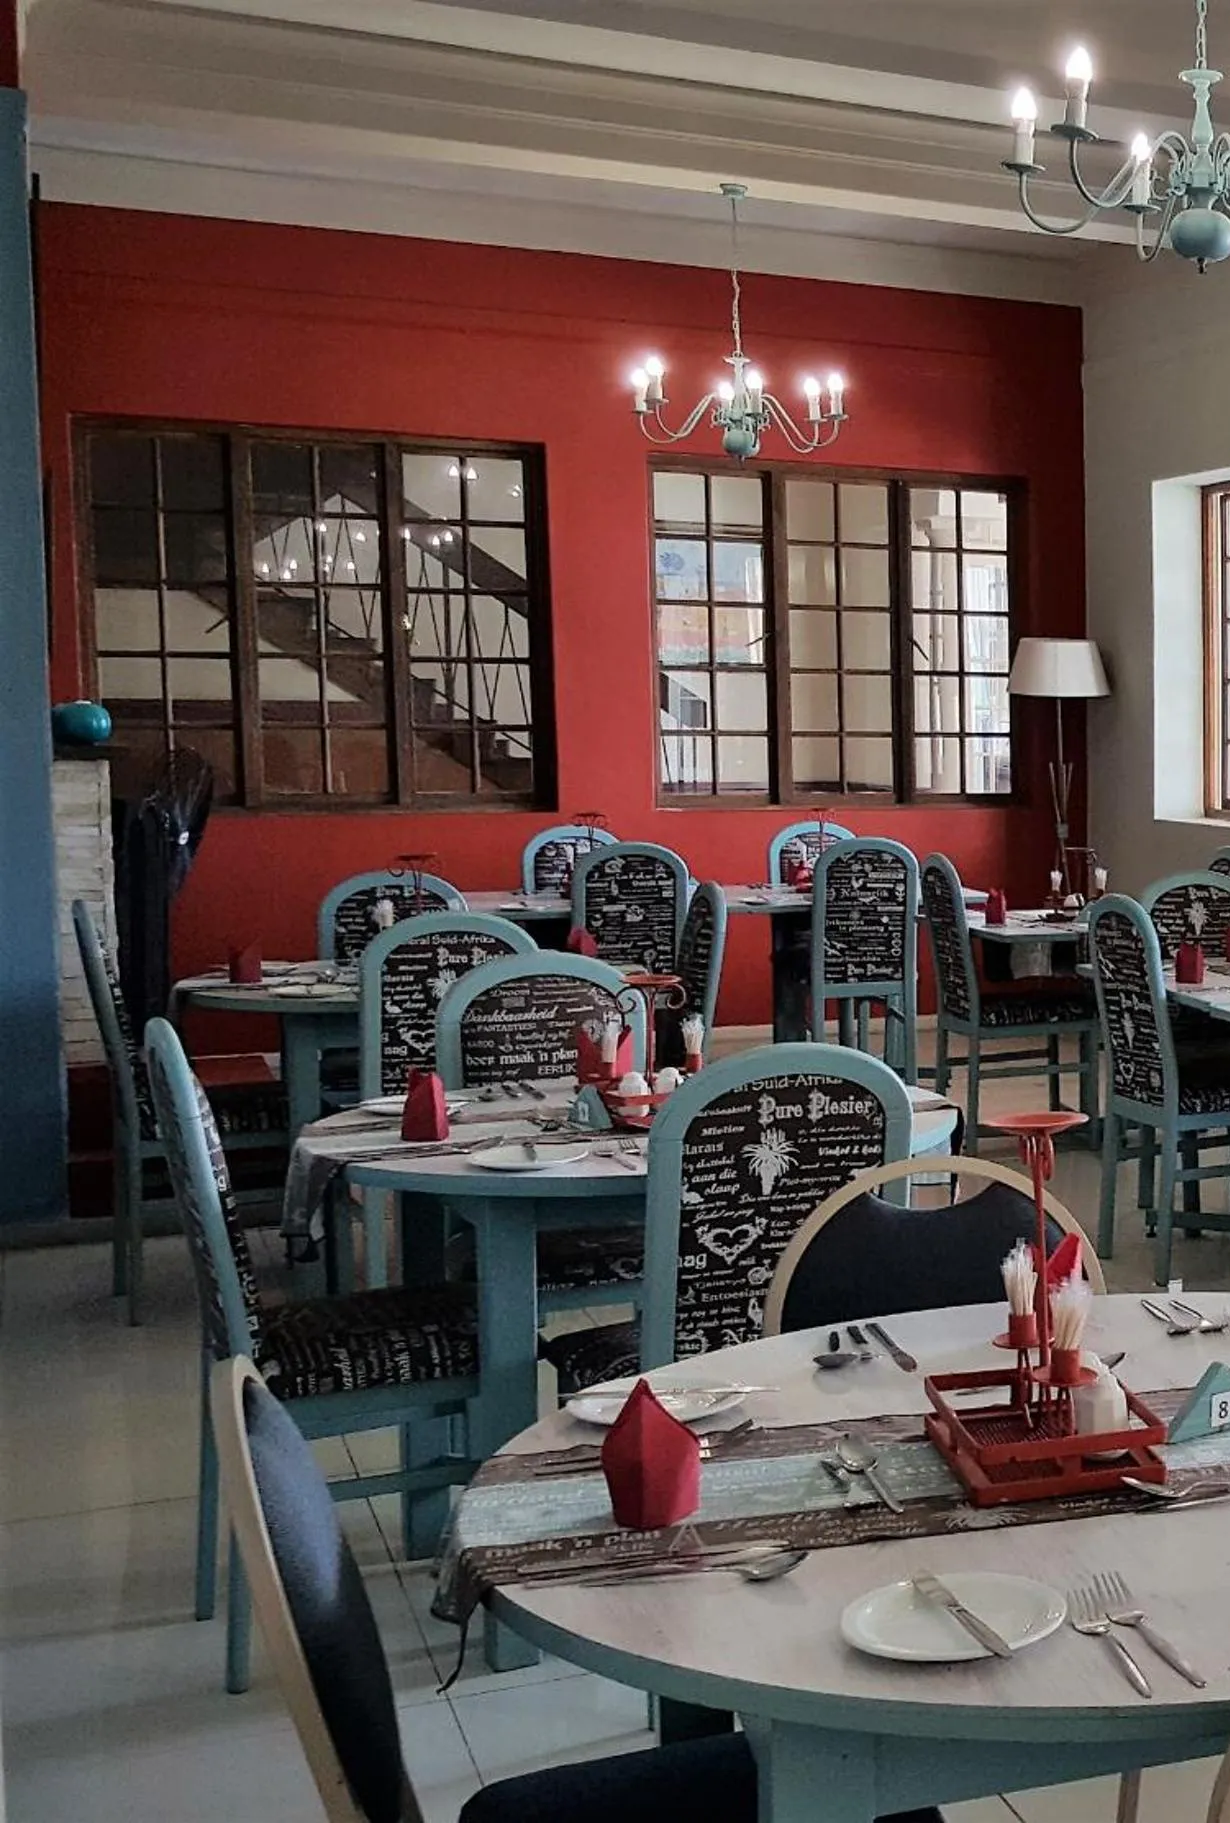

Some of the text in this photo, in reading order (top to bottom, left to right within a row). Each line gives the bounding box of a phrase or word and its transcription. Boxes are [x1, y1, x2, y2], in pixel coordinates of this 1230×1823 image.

[500, 1051, 535, 1065] maak
[757, 1092, 804, 1128] Pure
[806, 1086, 872, 1124] Plesier
[1219, 1401, 1228, 1419] 8
